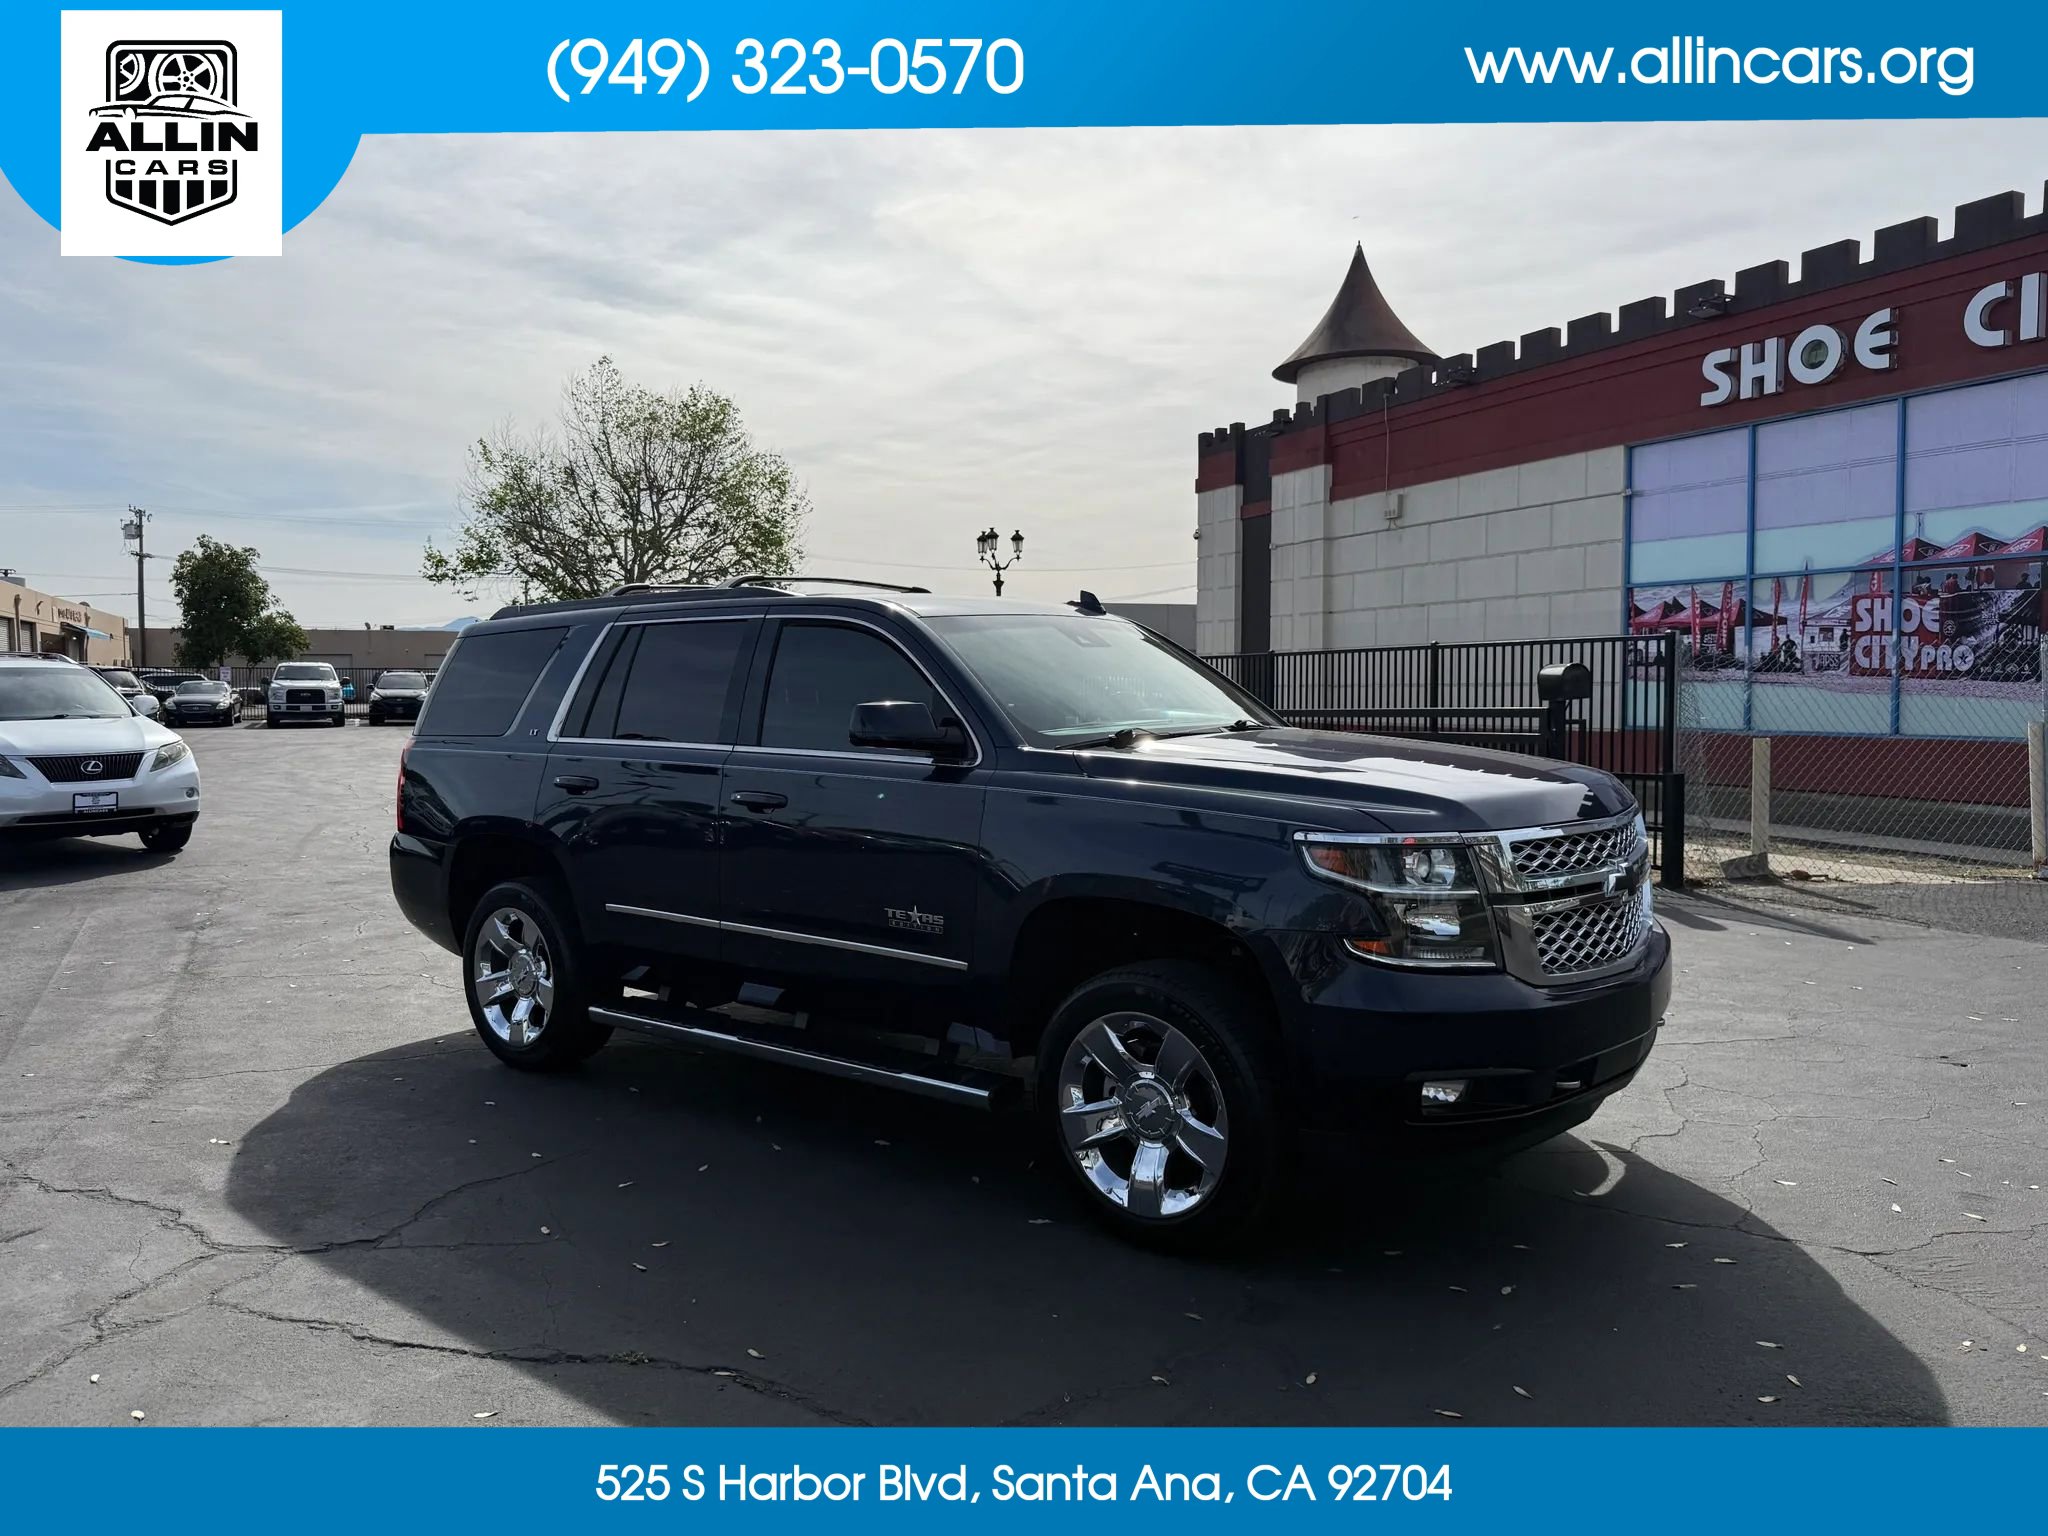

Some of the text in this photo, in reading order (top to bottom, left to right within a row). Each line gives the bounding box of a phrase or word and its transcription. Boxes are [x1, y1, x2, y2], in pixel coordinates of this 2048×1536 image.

[1701, 271, 2048, 408] SHOE CI
[1855, 597, 1940, 633] SHOE
[884, 905, 944, 925] TEXAS
